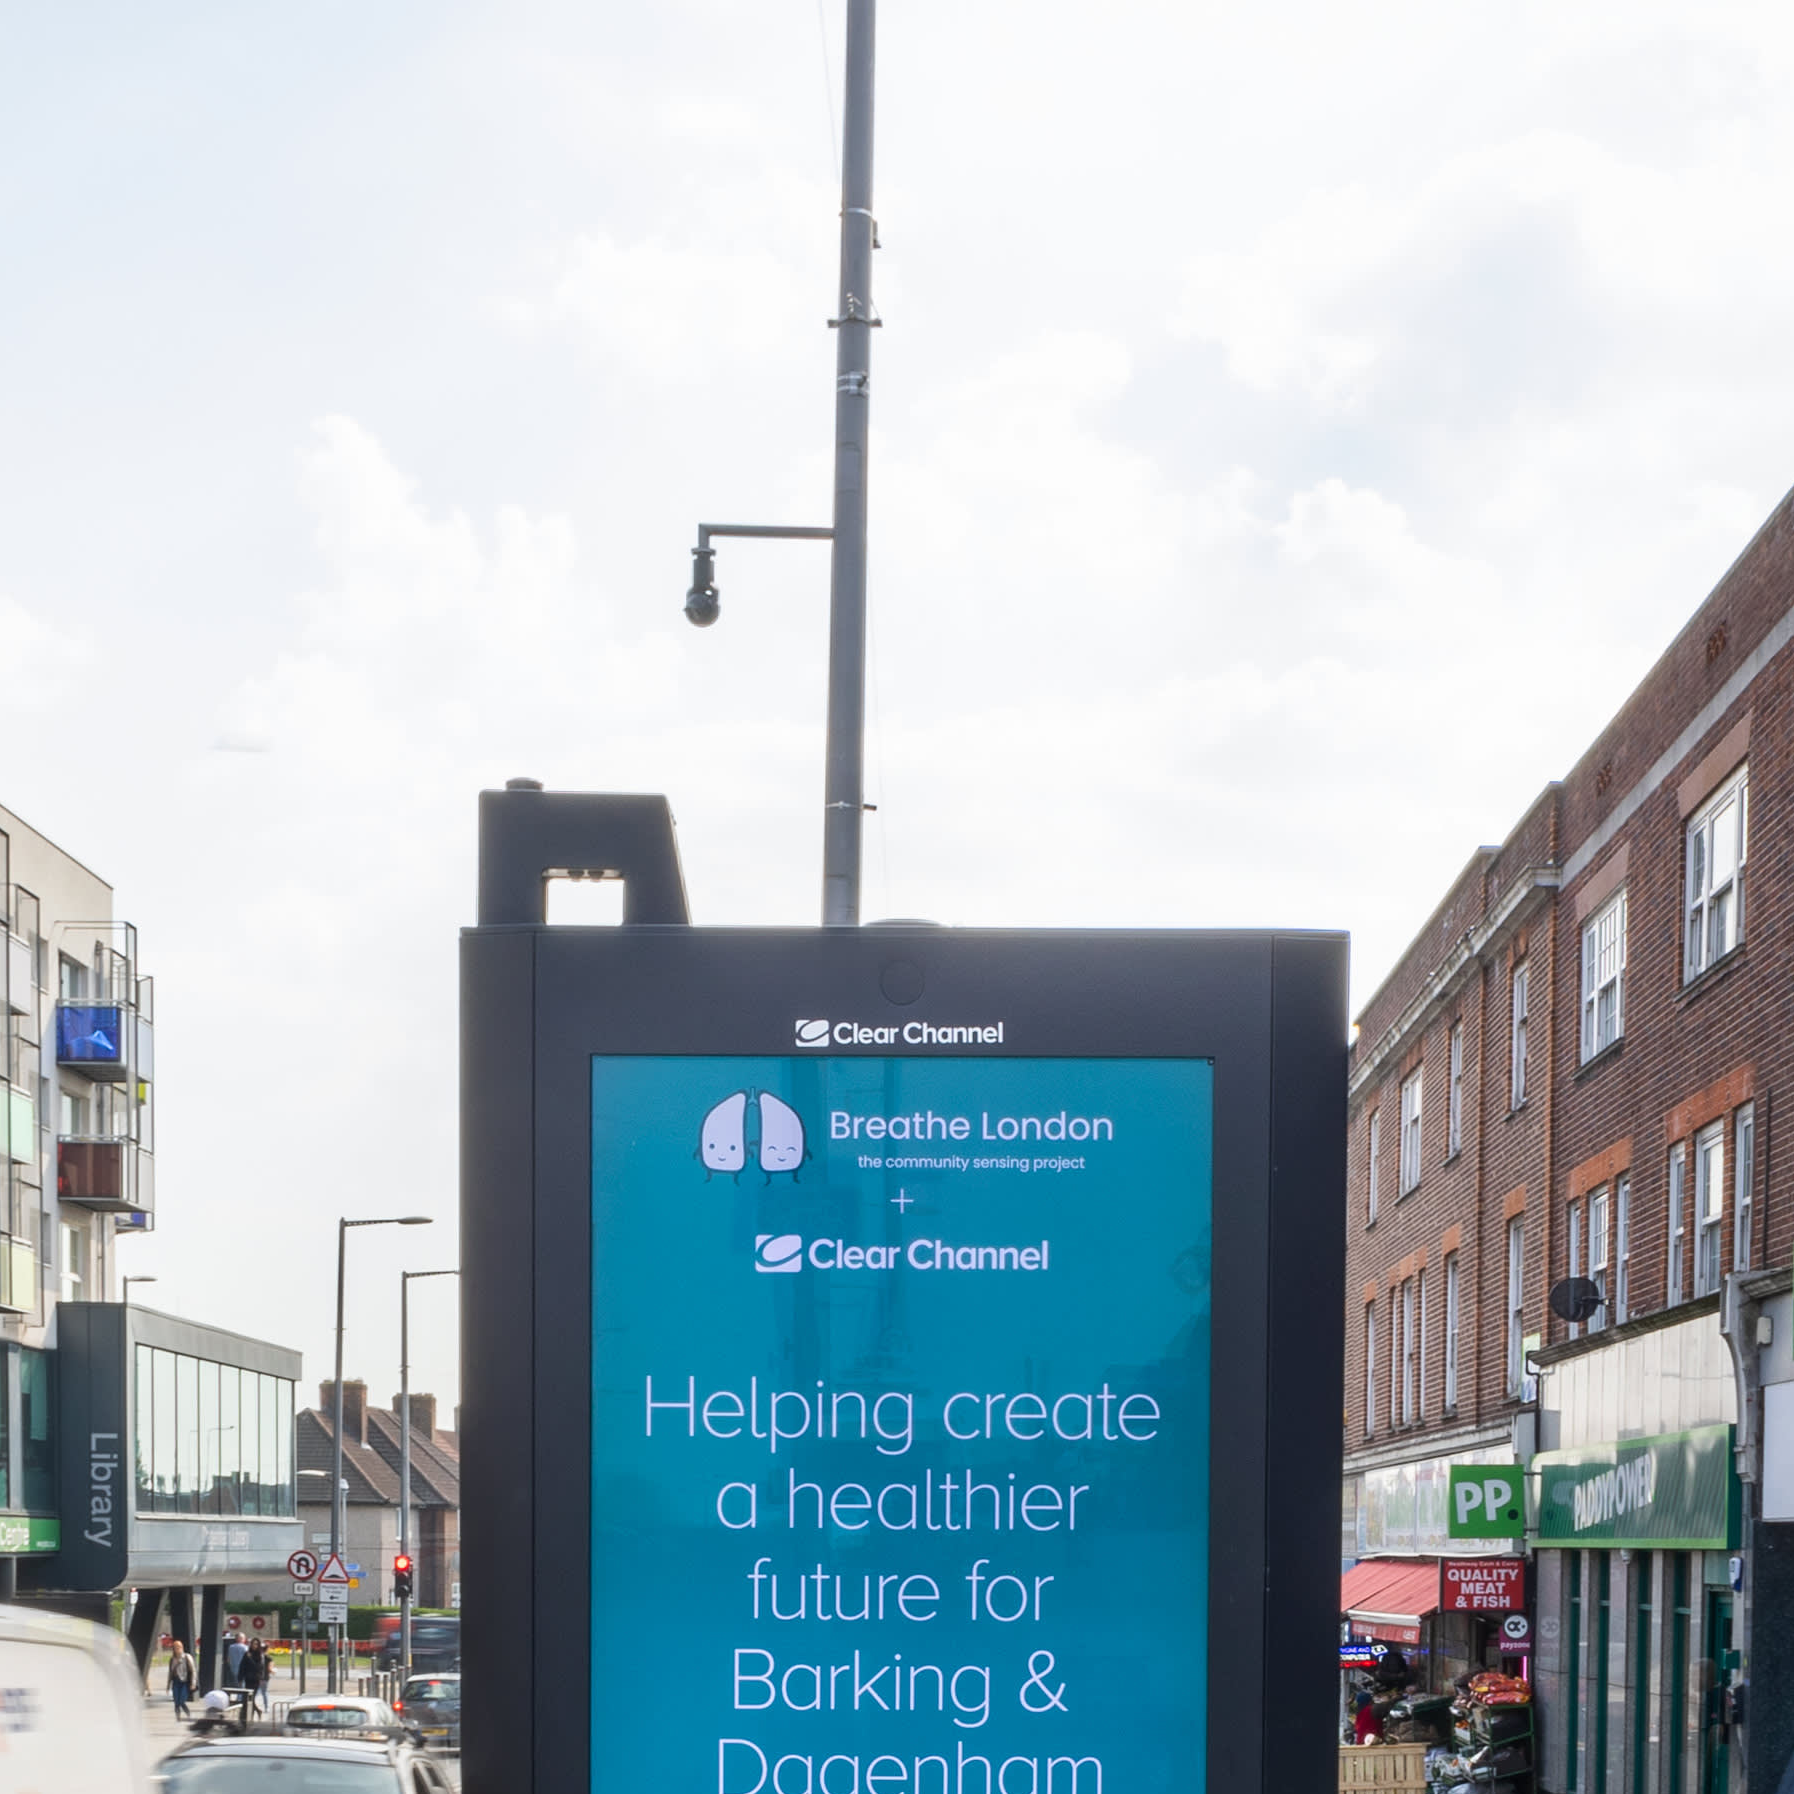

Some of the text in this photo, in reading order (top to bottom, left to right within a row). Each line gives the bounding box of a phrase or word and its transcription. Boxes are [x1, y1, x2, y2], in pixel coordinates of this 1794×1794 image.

[833, 1021, 1005, 1045] Clear Channel
[830, 1110, 1114, 1141] Breathe London
[858, 1156, 1086, 1174] the community sensing project
[808, 1238, 1050, 1272] Clear Channel
[645, 1374, 1162, 1457] Helping create
[84, 1433, 119, 1548] Library
[715, 1466, 1092, 1532] a healthier
[747, 1556, 1055, 1623] future for
[1447, 1569, 1519, 1582] QUALITY
[1460, 1582, 1506, 1595] MEAT
[1455, 1596, 1511, 1608] & FISH
[733, 1648, 1069, 1729] Barking &
